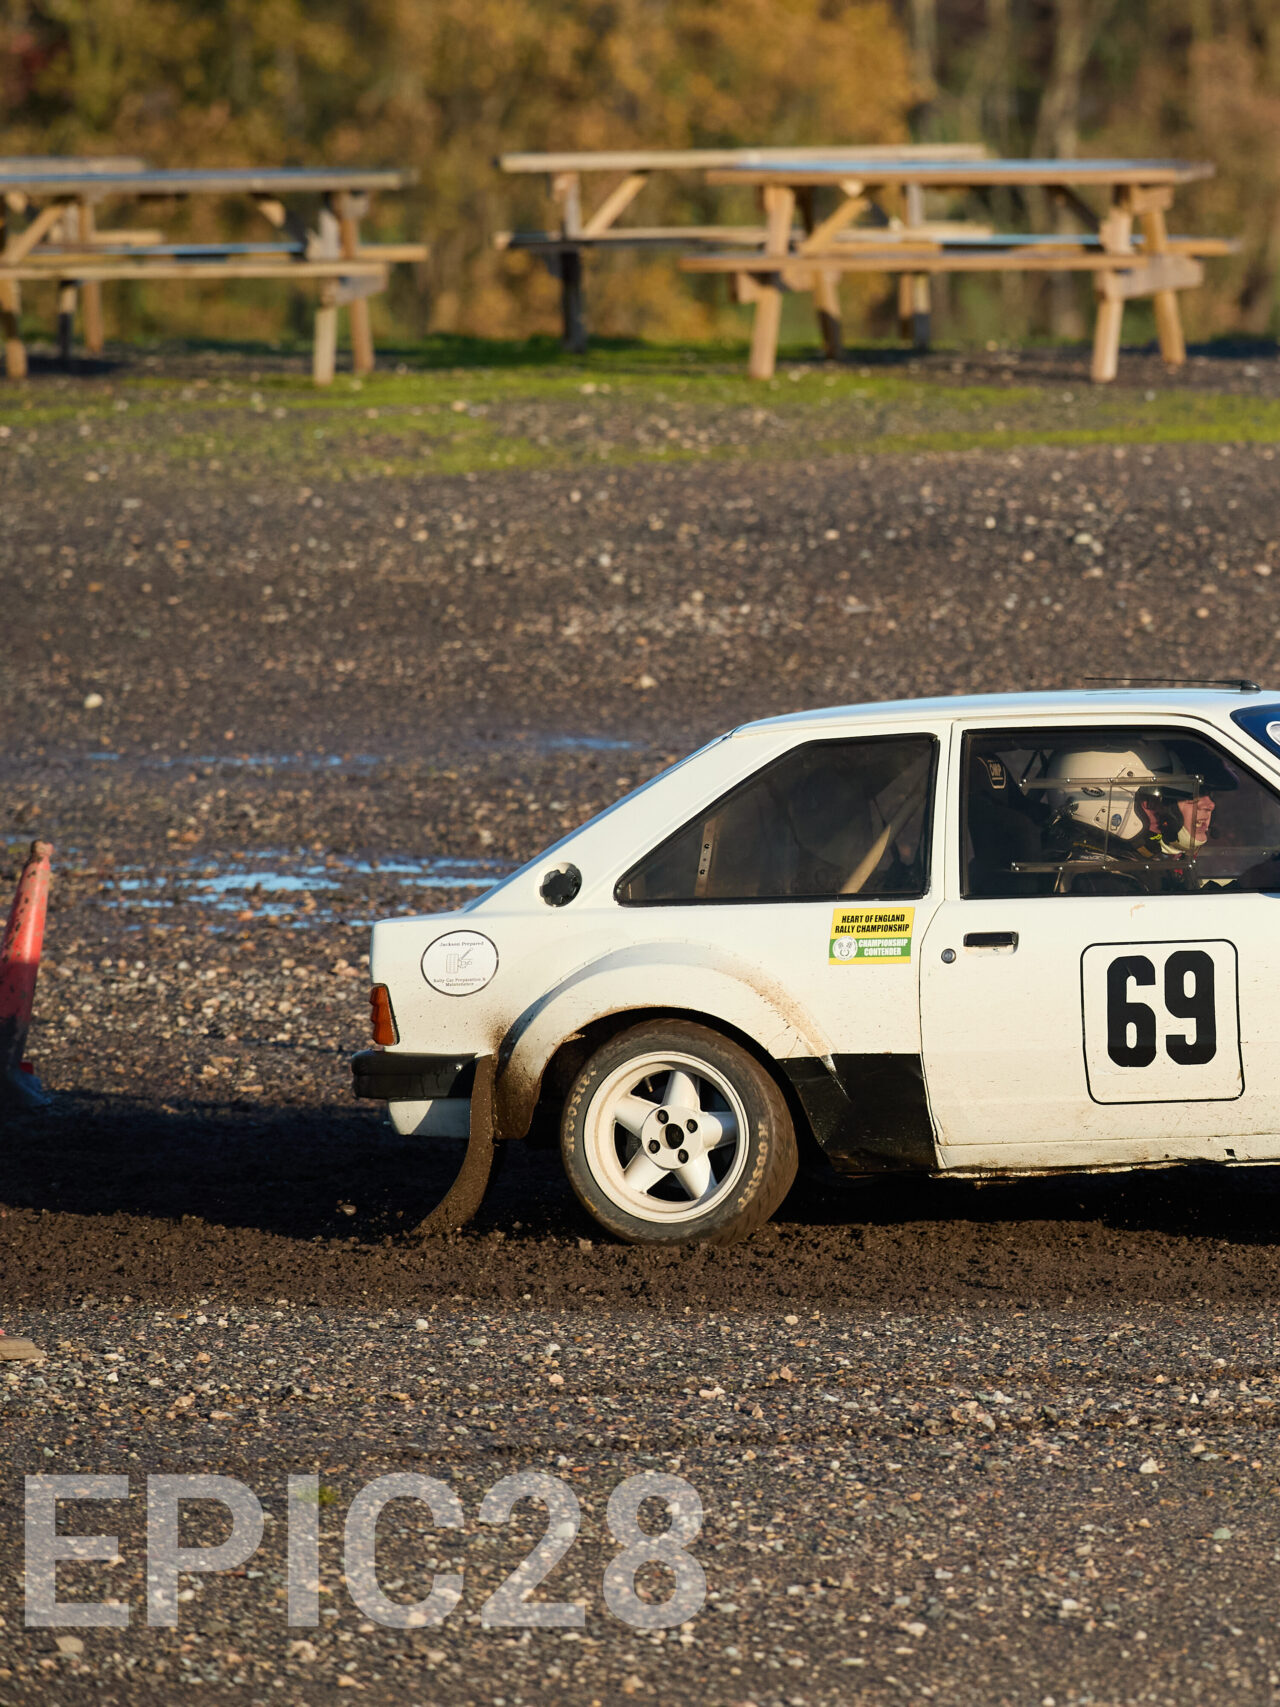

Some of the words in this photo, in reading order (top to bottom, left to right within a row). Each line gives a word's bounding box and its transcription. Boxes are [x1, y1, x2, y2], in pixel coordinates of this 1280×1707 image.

[842, 915, 863, 923] HEART
[874, 914, 905, 922] ENGLAND
[834, 925, 855, 933] RALLY
[856, 924, 909, 933] CHAMPIONSHIP
[859, 939, 908, 947] CHAMPIONSHIP
[864, 948, 901, 956] CONTENDER
[1107, 950, 1217, 1067] 69
